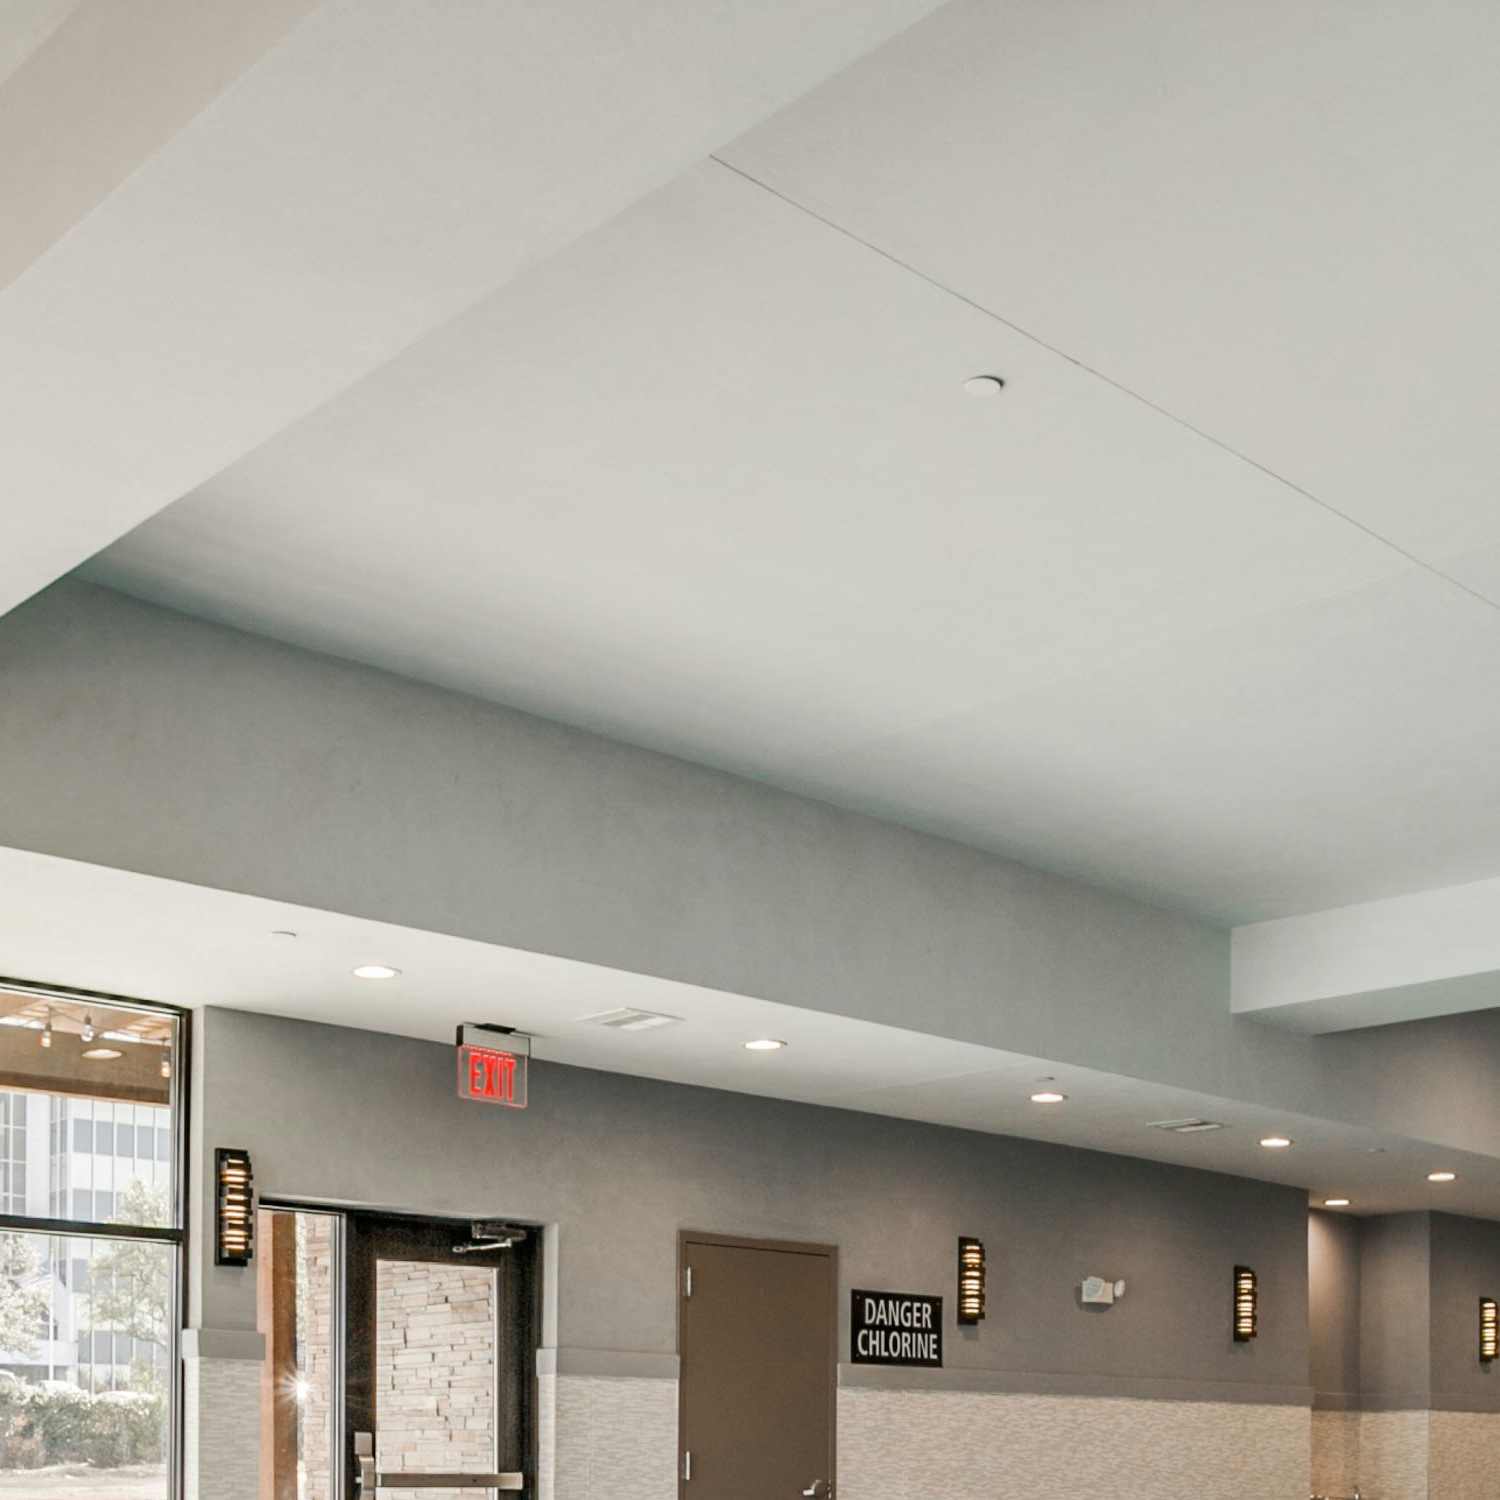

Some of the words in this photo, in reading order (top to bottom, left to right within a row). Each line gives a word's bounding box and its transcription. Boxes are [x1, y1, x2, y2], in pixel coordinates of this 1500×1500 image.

[469, 1051, 516, 1102] EXIT
[865, 1298, 932, 1329] DANGER
[857, 1329, 938, 1360] CHLORINE
